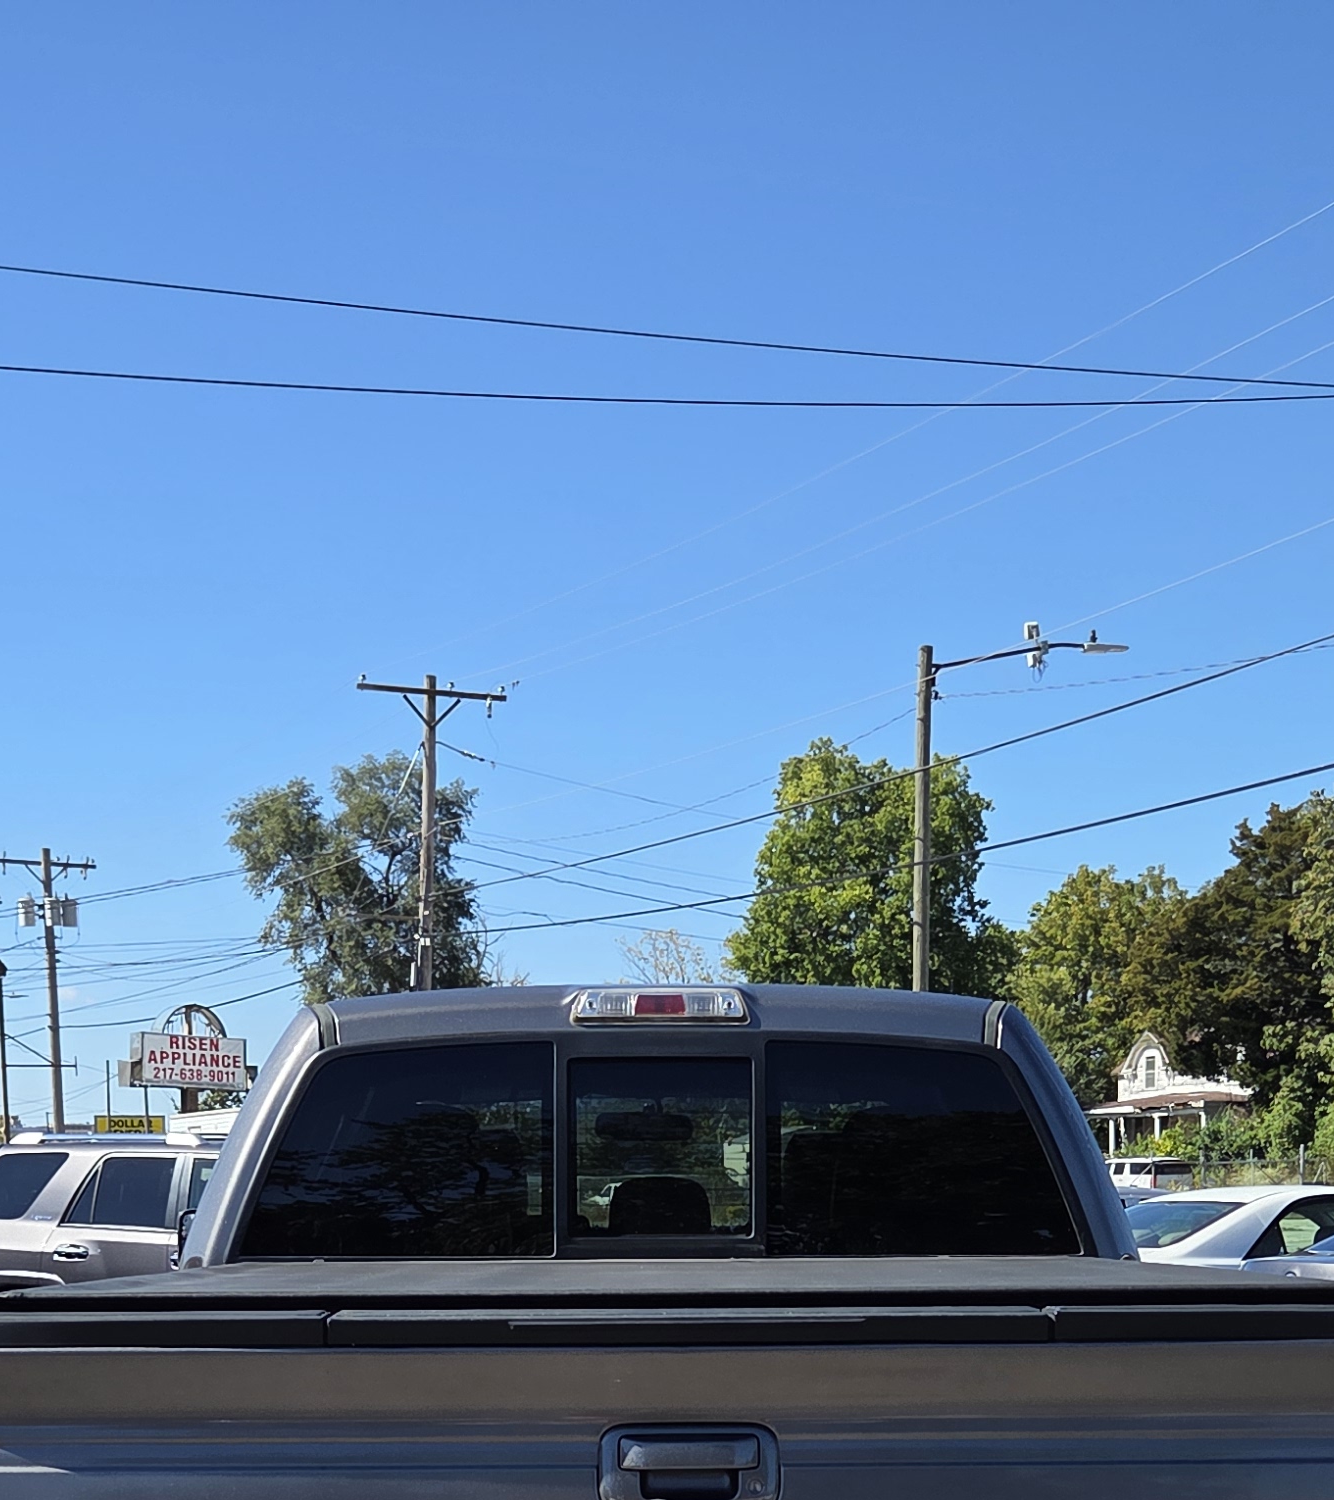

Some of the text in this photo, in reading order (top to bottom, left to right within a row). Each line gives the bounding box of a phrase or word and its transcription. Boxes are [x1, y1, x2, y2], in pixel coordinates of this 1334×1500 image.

[169, 1035, 220, 1052] RISEN
[148, 1050, 242, 1069] APPLIANCE
[153, 1066, 236, 1083] 217-638-9011
